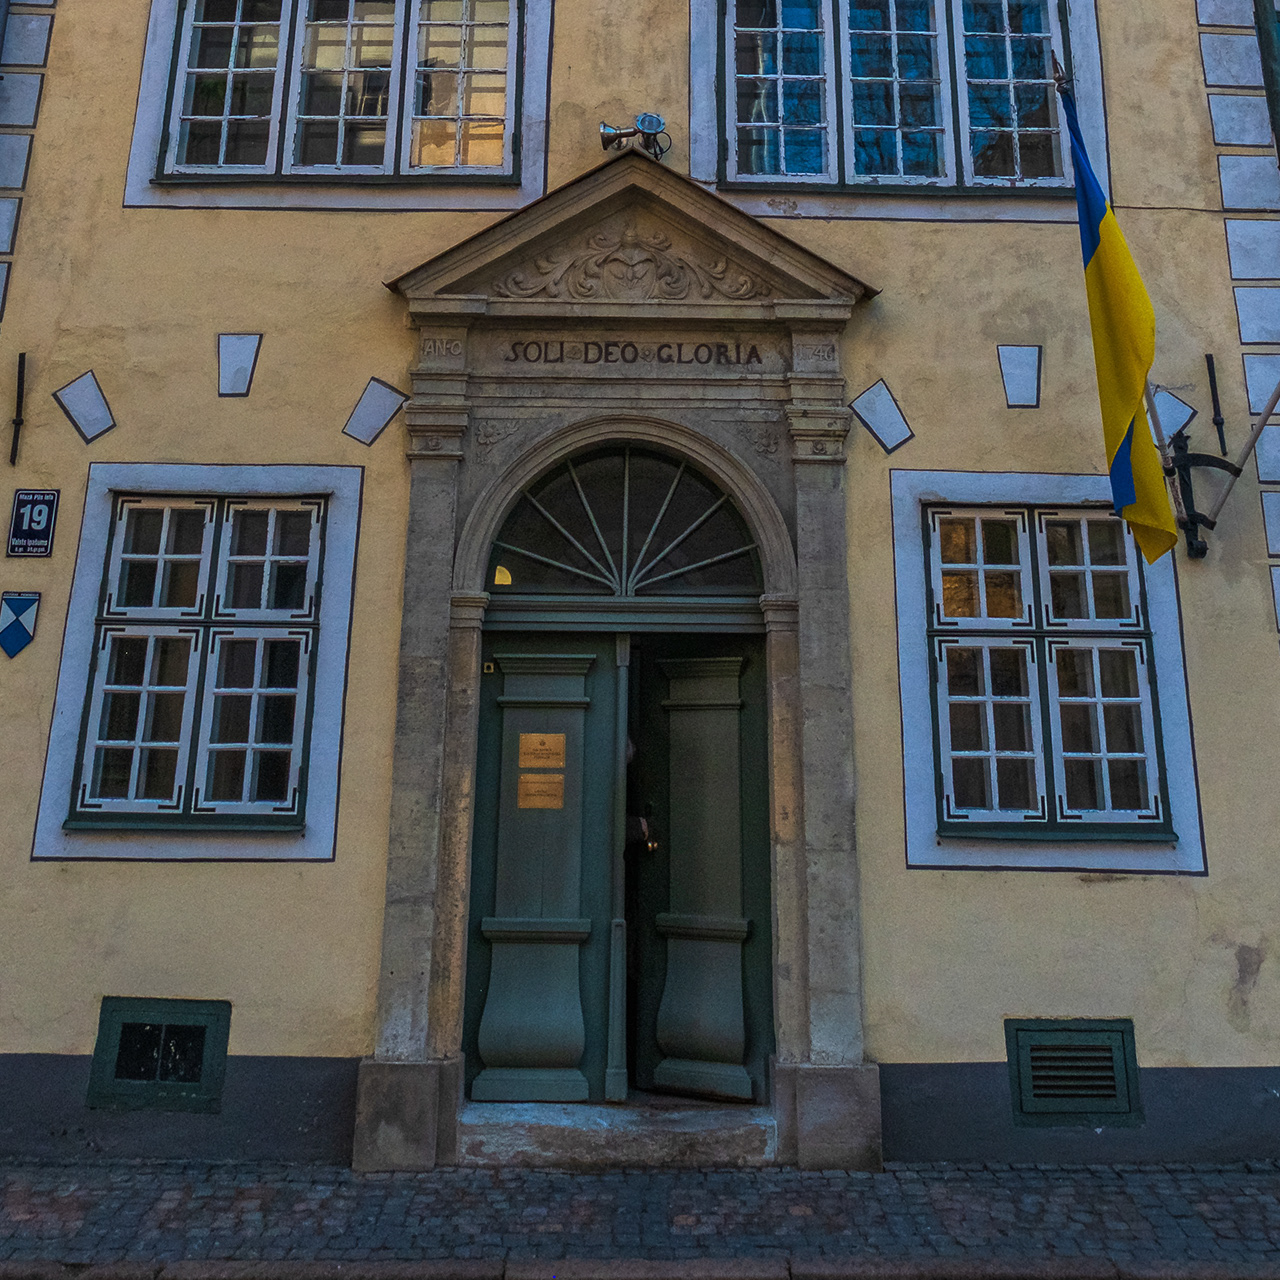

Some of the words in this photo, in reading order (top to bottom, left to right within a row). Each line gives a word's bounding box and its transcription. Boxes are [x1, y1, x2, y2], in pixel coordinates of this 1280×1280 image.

[504, 341, 565, 363] SOLI
[583, 341, 639, 364] DEO
[657, 342, 763, 365] GLORIA
[20, 504, 49, 530] 19
